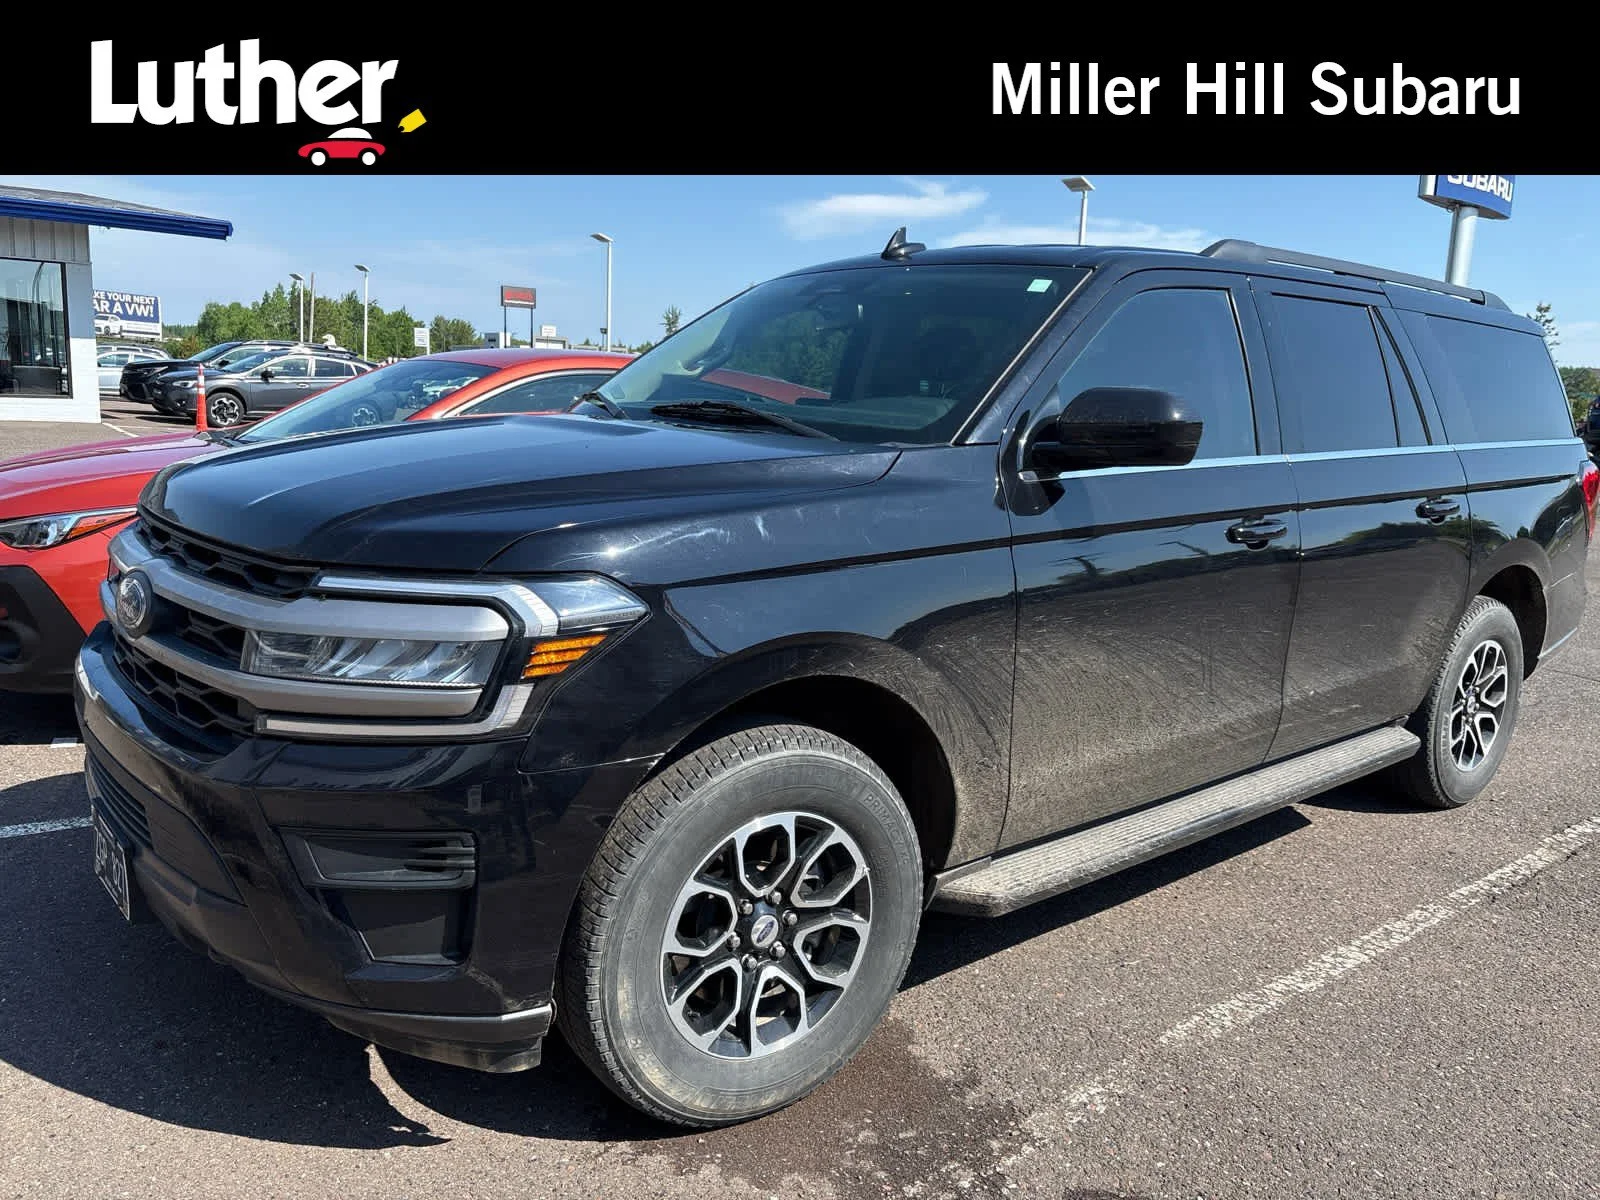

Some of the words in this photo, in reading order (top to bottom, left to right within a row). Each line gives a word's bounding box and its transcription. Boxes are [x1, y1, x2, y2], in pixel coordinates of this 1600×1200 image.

[107, 291, 131, 303] YOUR
[133, 295, 155, 305] NEXT
[113, 301, 123, 315] A
[125, 303, 154, 318] VW!
